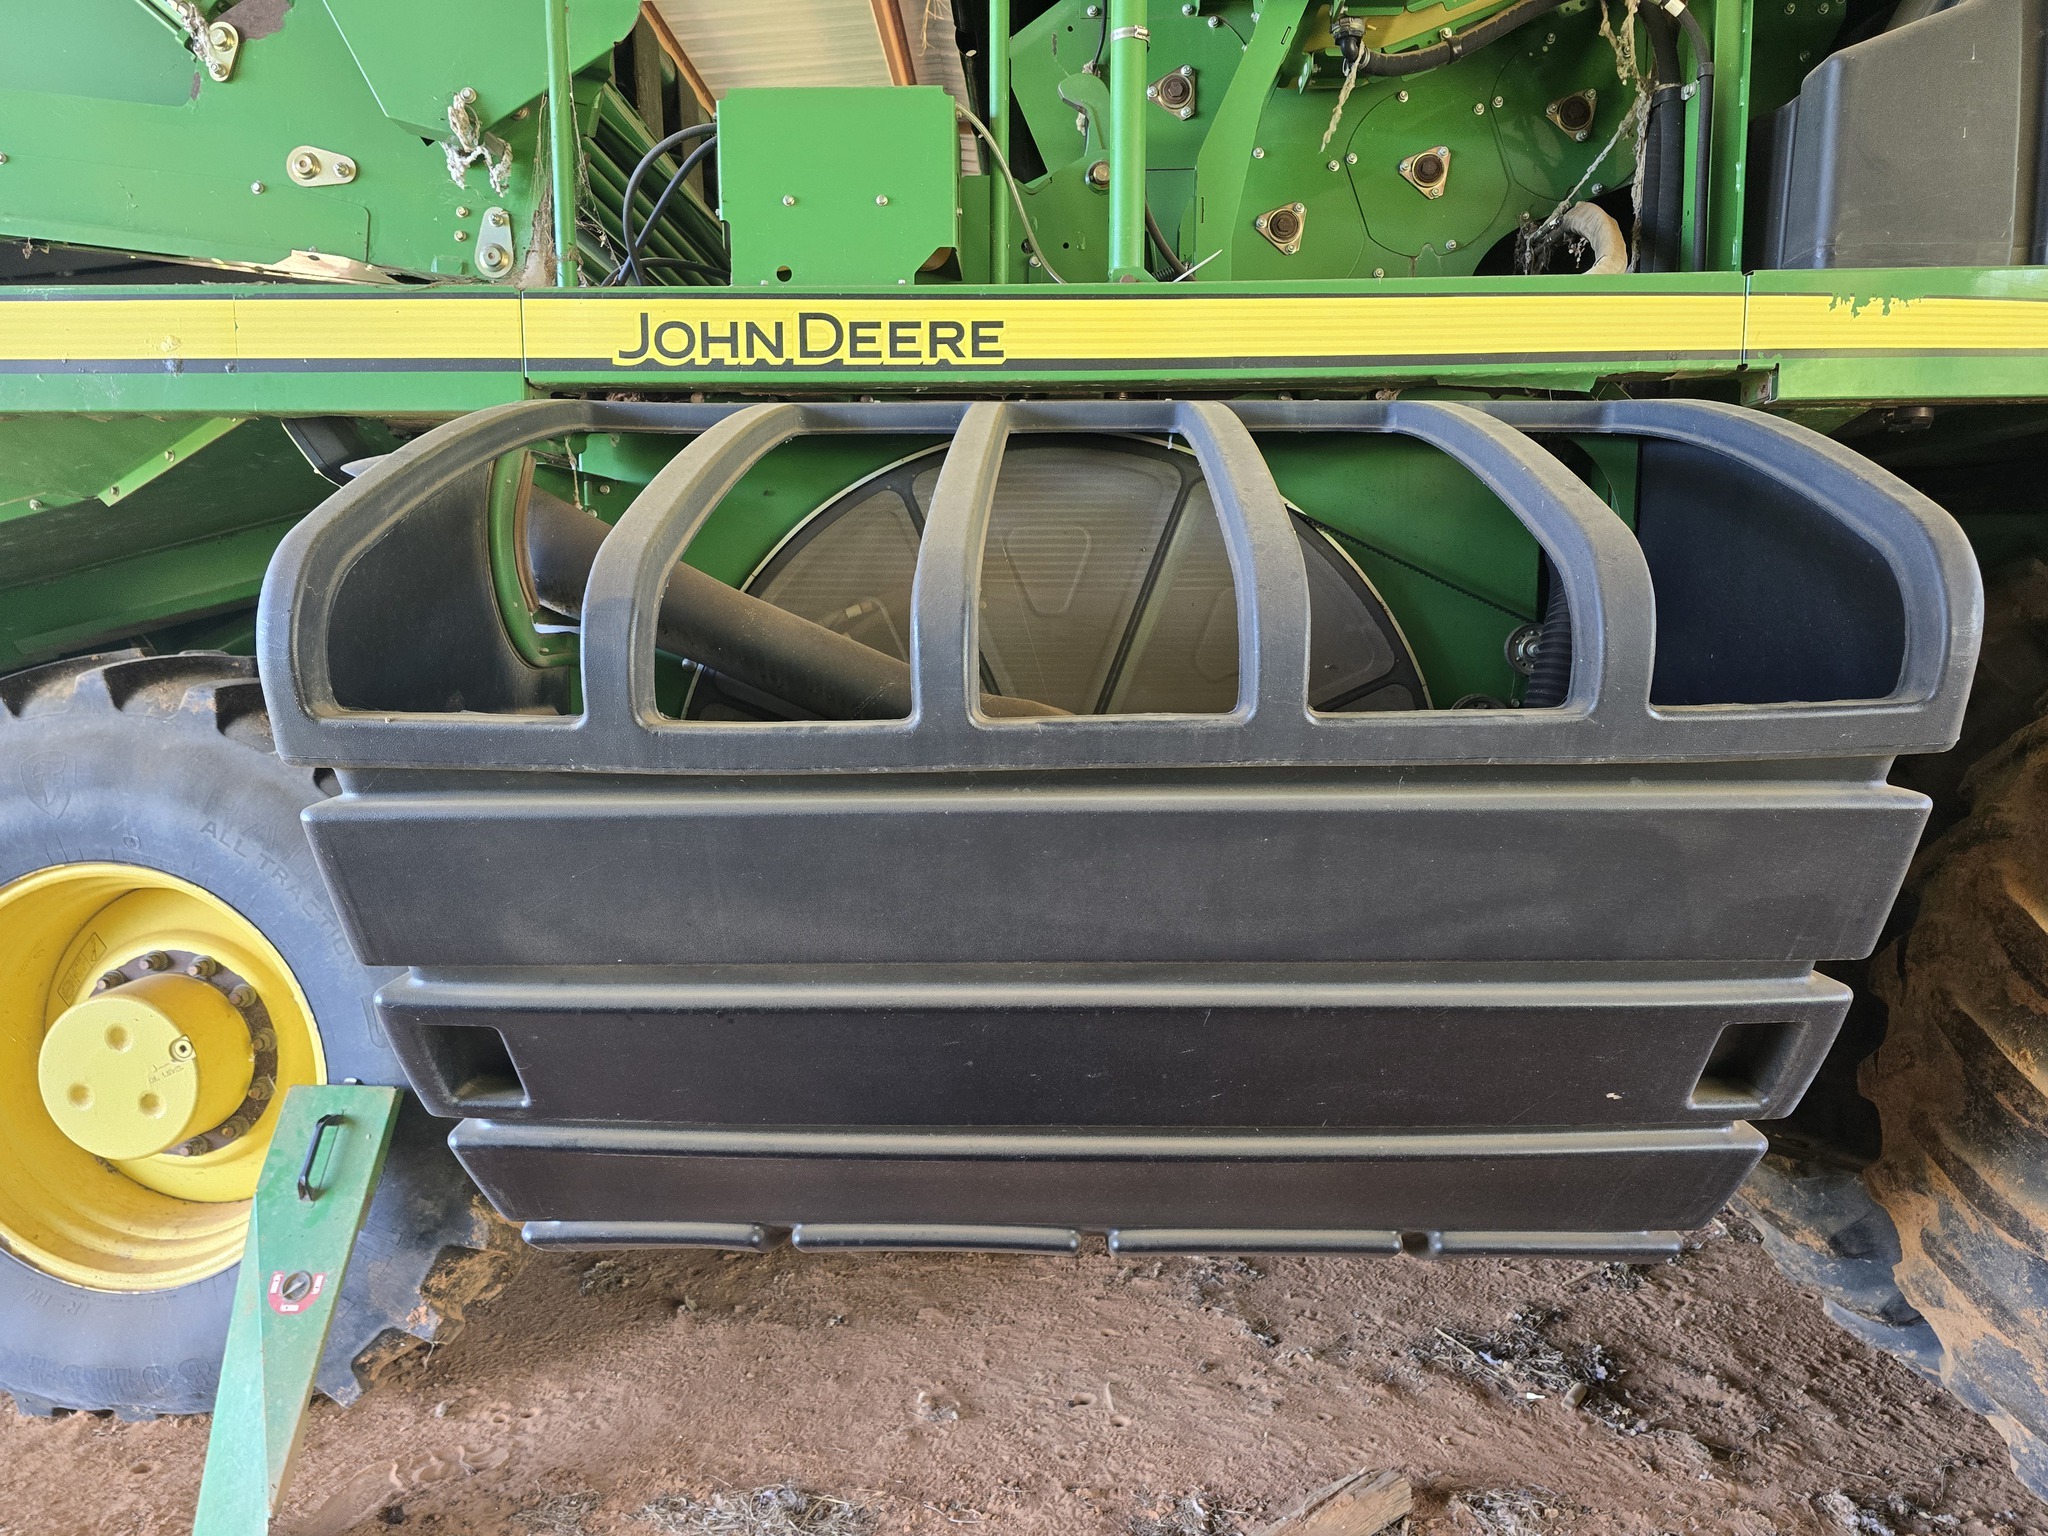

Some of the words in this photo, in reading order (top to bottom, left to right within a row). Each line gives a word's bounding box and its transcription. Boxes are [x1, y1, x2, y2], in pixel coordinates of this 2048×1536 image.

[618, 312, 784, 359] JOHN
[798, 312, 1005, 358] DEERE
[200, 820, 247, 858] ALL
